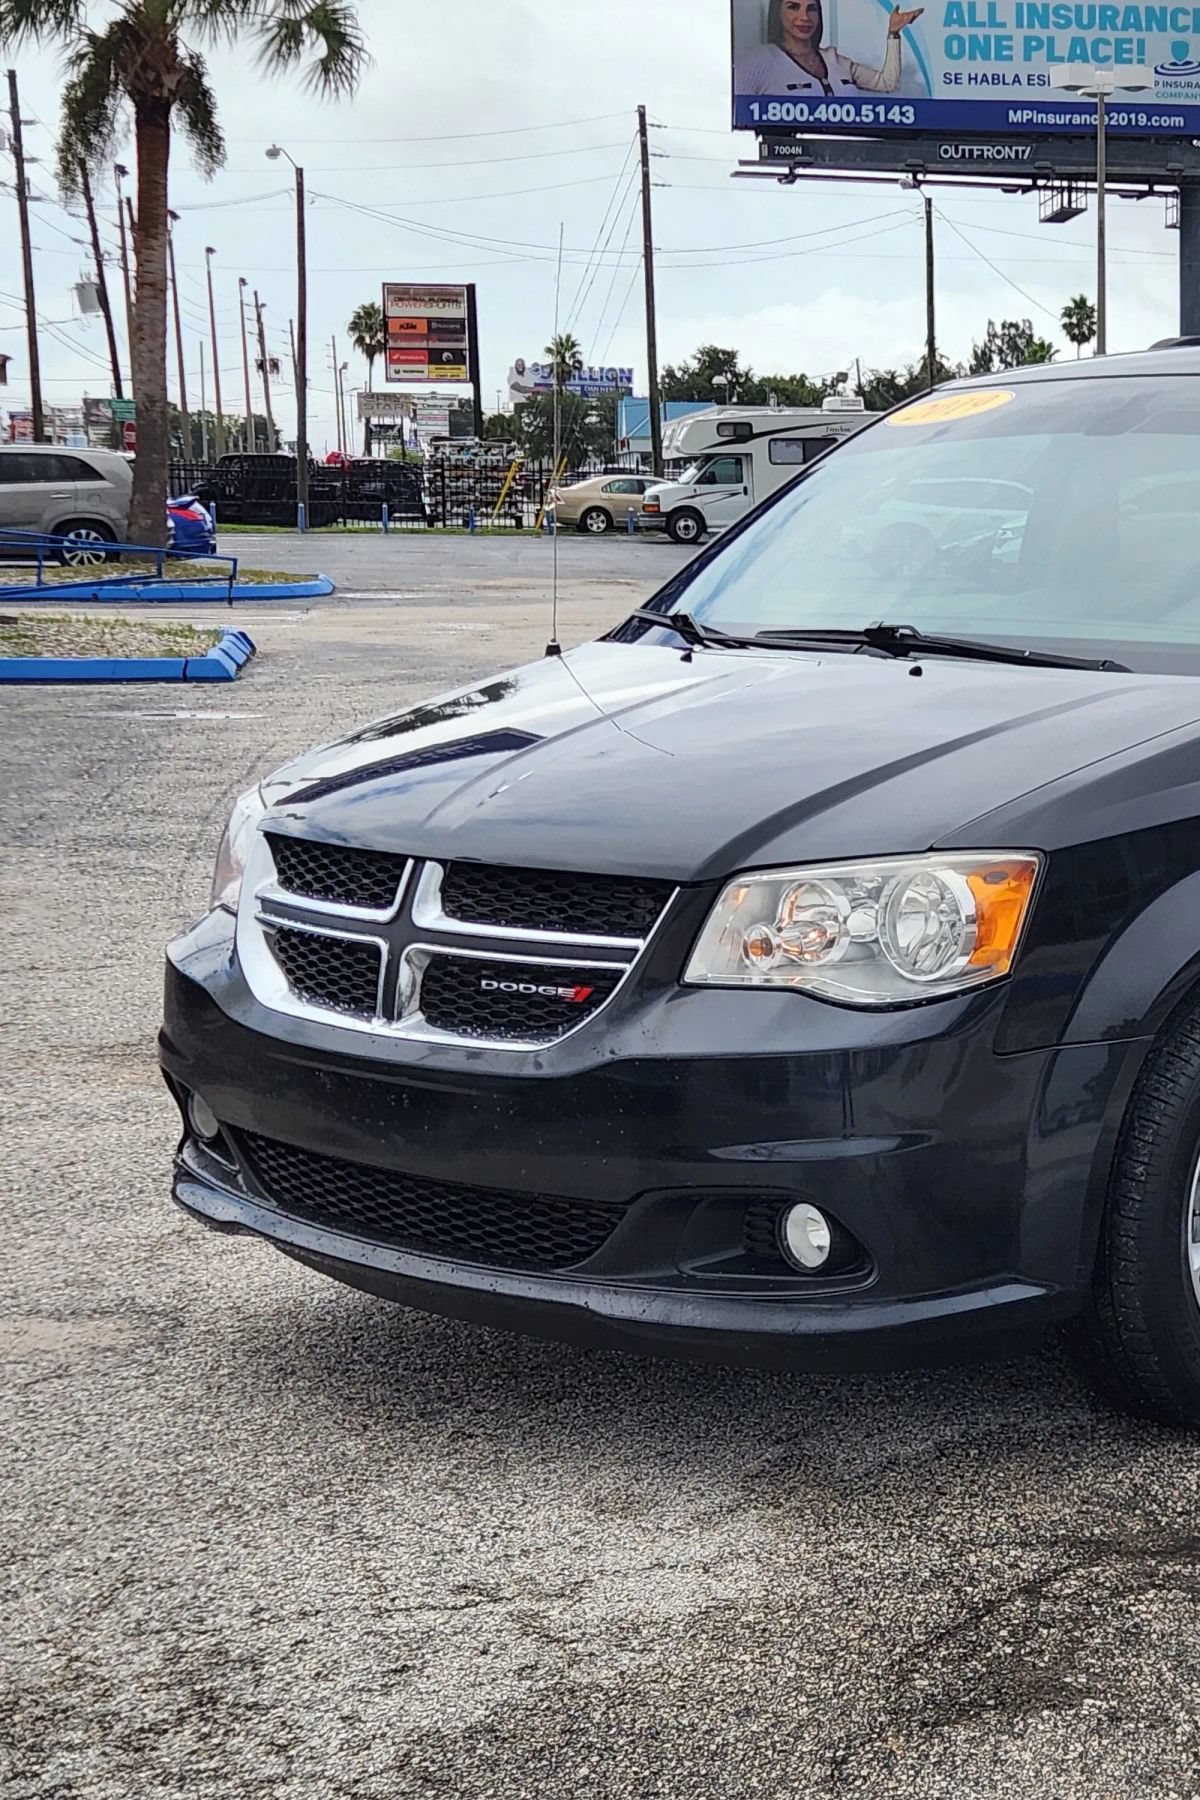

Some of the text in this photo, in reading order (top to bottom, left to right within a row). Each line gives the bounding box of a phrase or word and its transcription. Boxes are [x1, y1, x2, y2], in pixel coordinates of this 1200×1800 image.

[943, 1, 1007, 28] ALL
[944, 34, 1146, 64] ONE PLACE!
[942, 72, 1050, 87] SE HABLA ES
[748, 102, 915, 124] 1.800.400.5143
[773, 145, 802, 155] 7004N
[481, 979, 576, 998] DODGE
